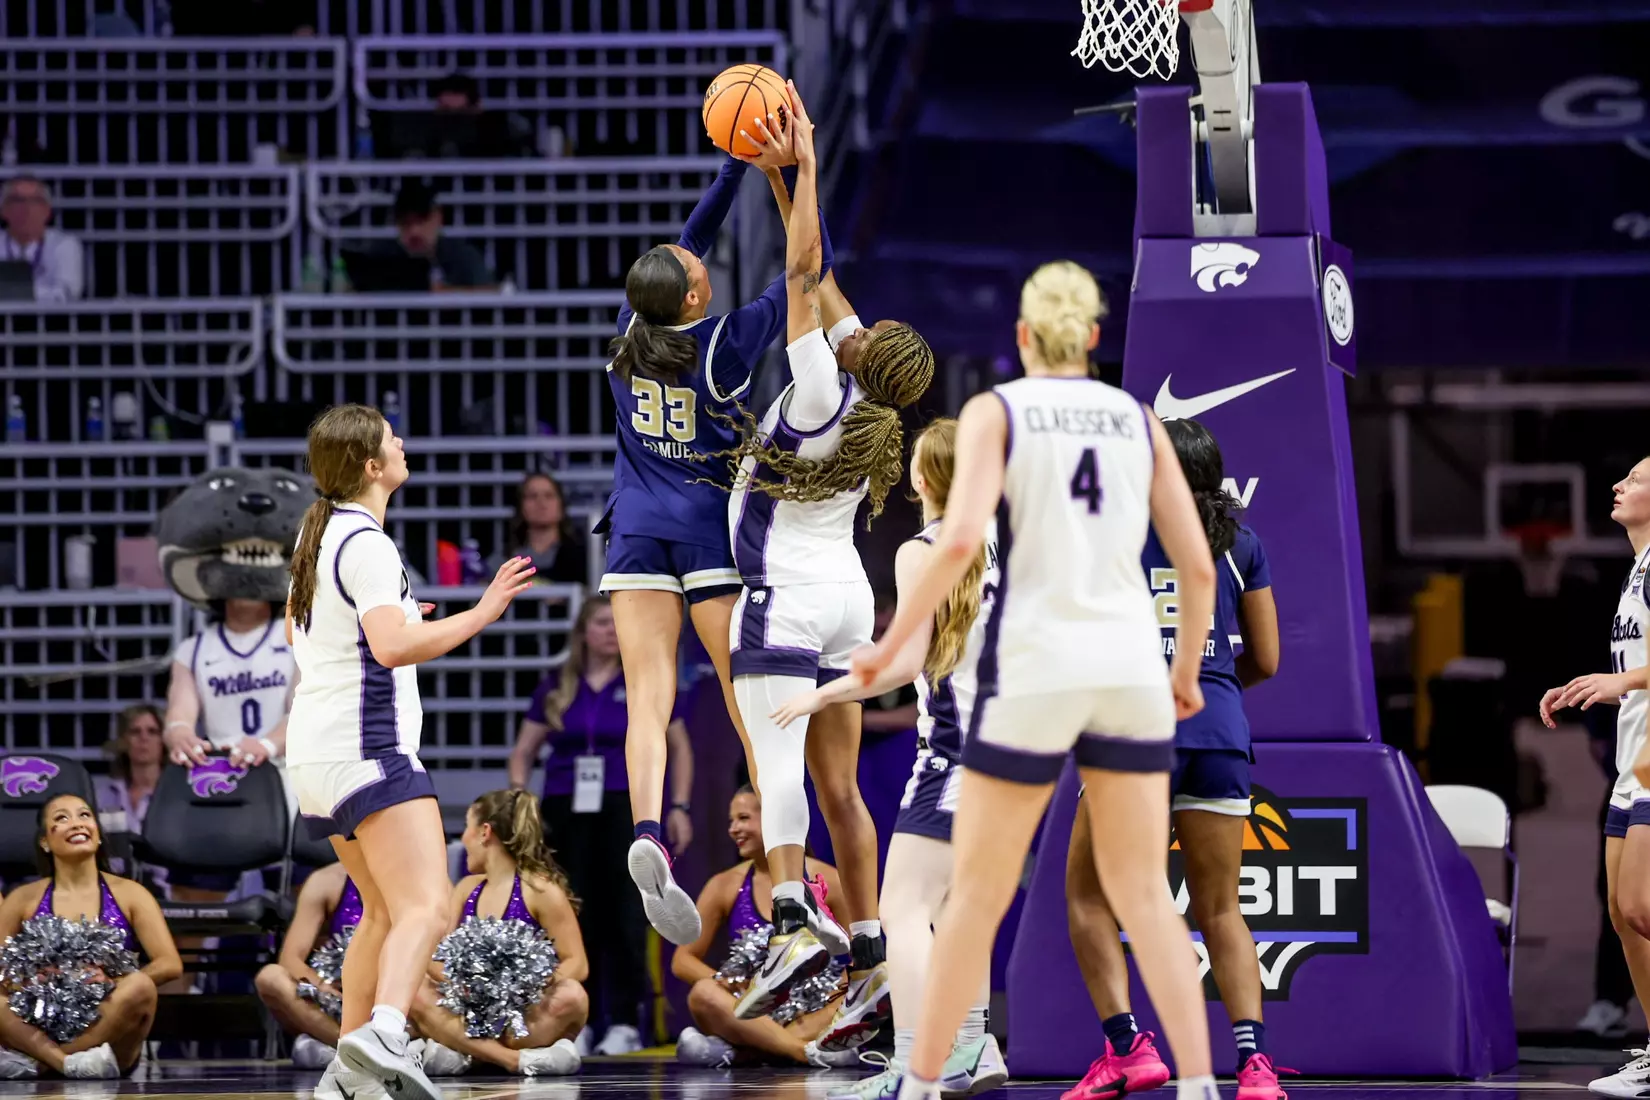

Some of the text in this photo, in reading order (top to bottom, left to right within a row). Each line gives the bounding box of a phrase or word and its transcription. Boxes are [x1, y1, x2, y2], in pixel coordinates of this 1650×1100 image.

[631, 374, 697, 443] 33
[1070, 447, 1104, 515] 4
[208, 670, 287, 697] Wildcats
[241, 698, 262, 736] 0
[1166, 865, 1358, 916] BIT
